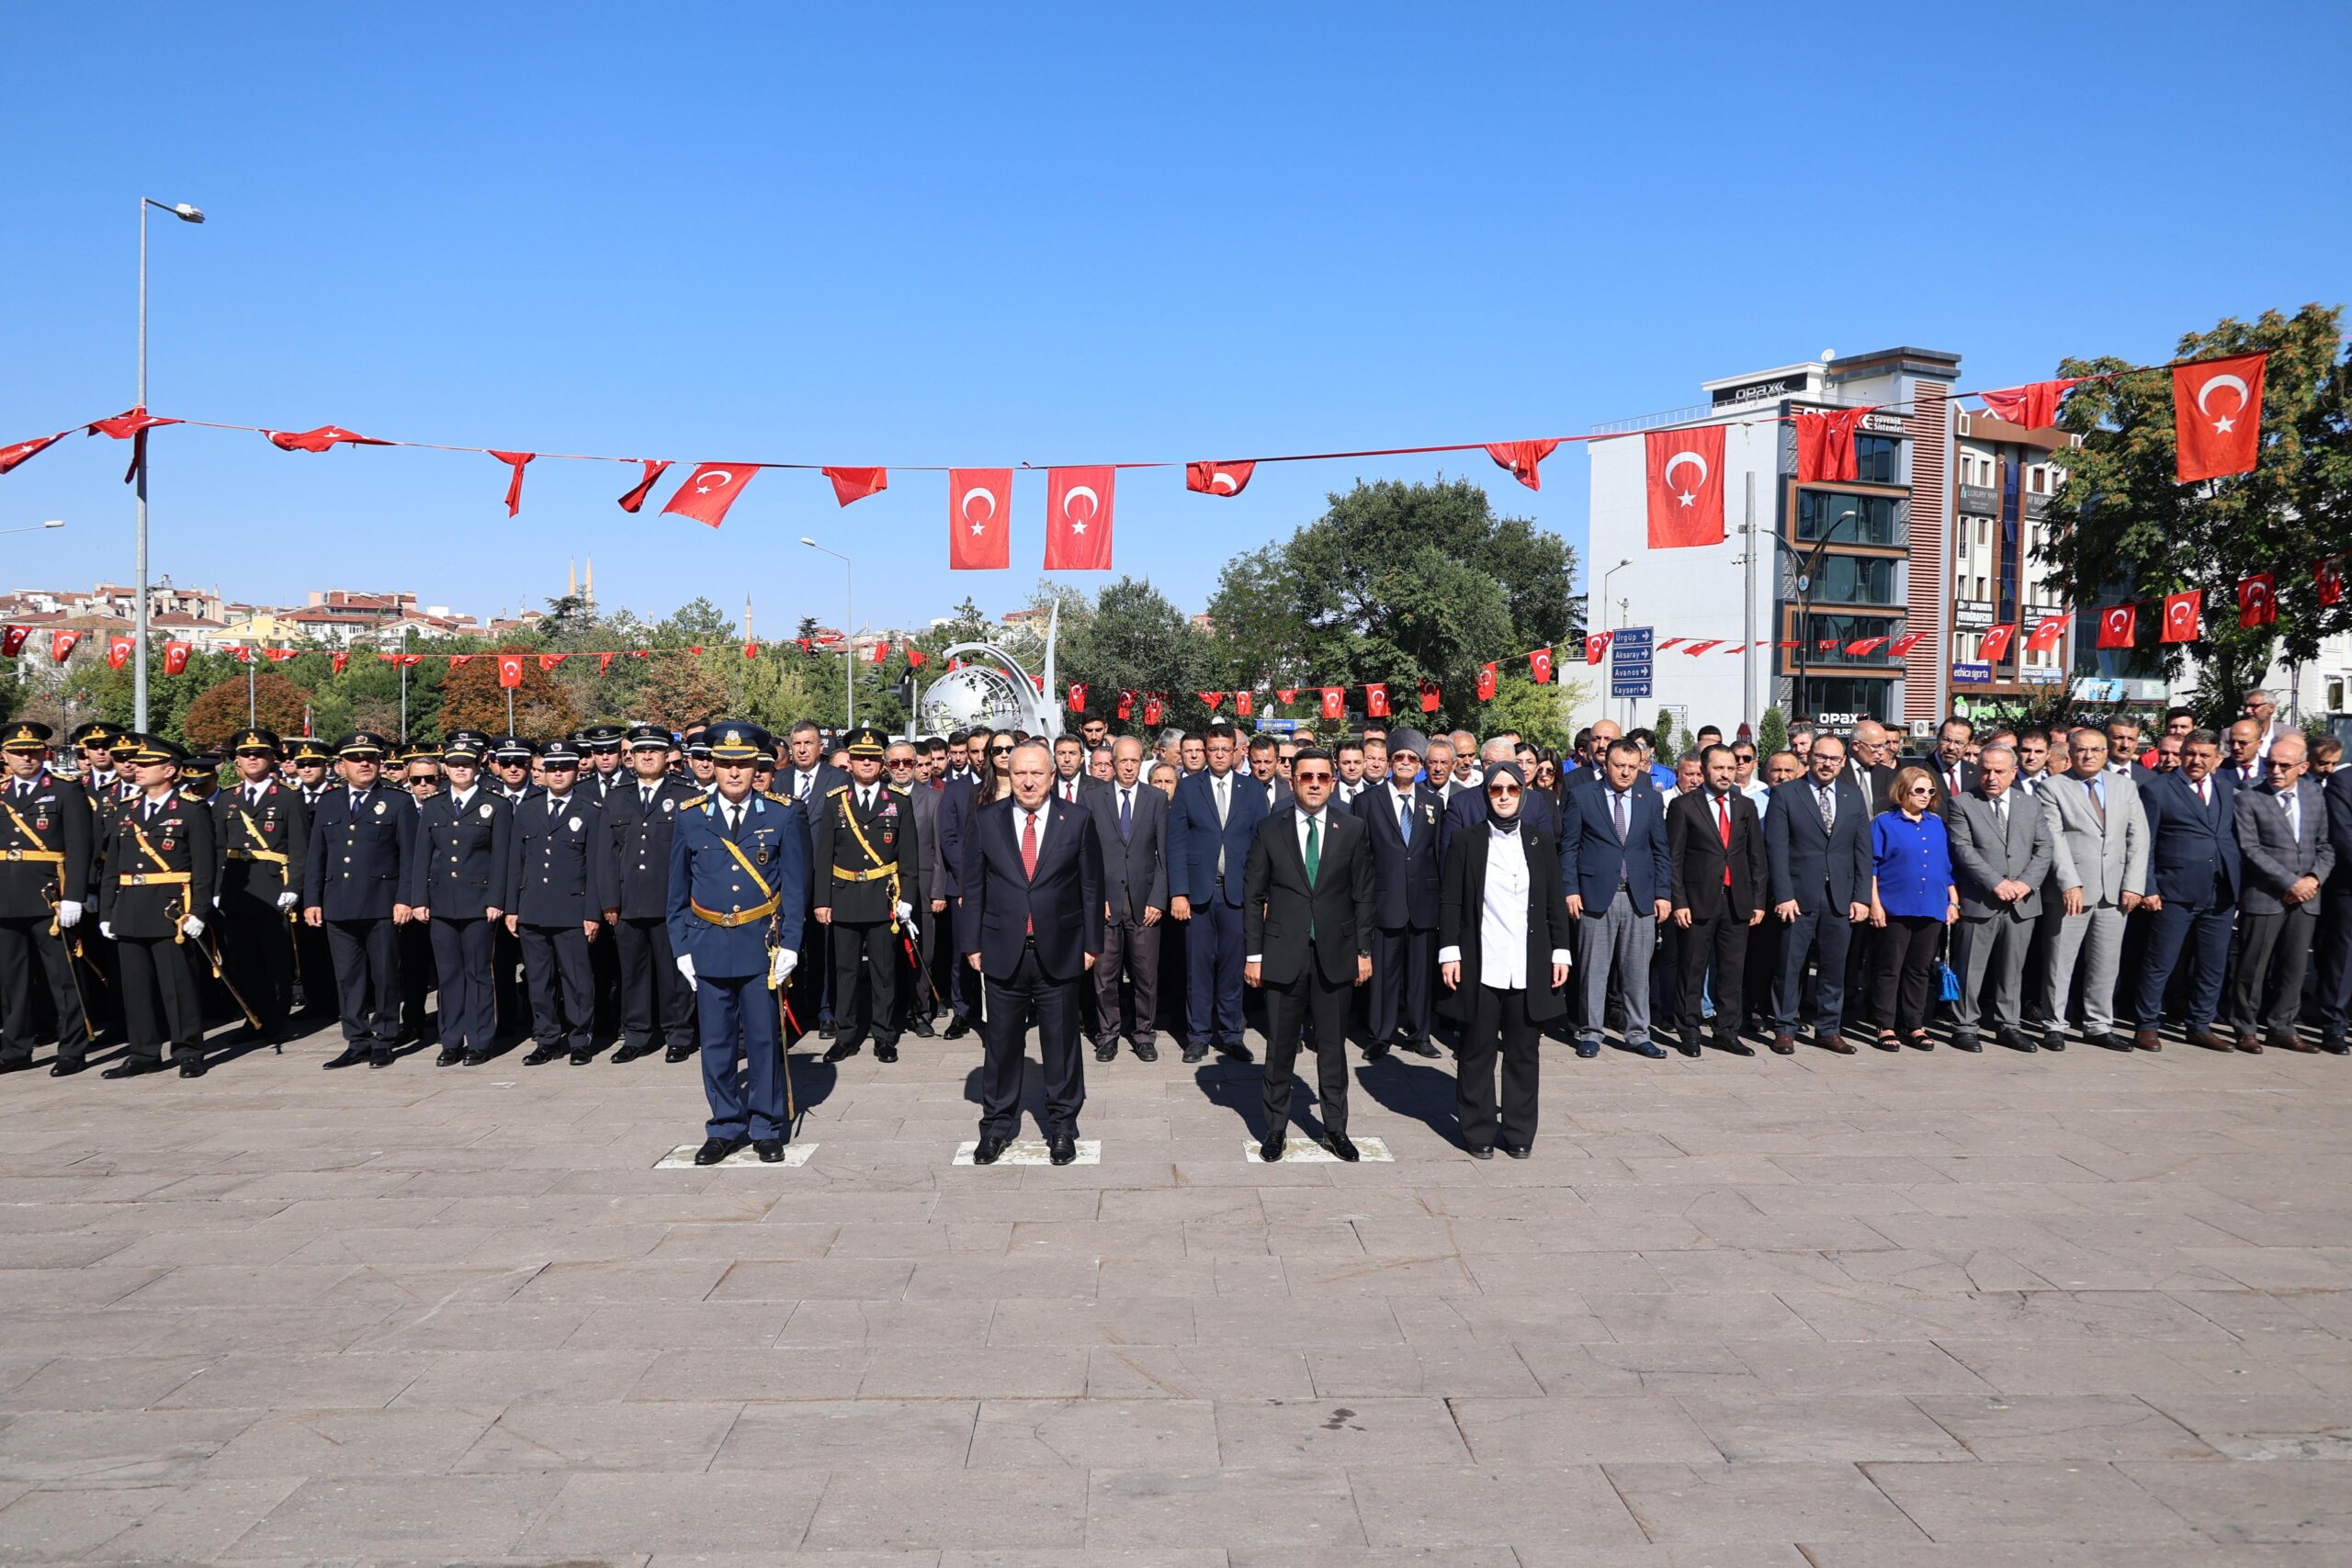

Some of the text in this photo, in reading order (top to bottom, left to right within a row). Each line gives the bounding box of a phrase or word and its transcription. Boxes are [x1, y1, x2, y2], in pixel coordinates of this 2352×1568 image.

[1874, 414, 1902, 424] Güvenlik
[1874, 423, 1905, 433] Sistemleri
[1615, 631, 1636, 642] Ürgüp
[1615, 649, 1640, 660] Aksaray
[1614, 669, 1640, 677] Avanos
[1953, 667, 1972, 678] ethica
[1614, 686, 1639, 695] Kayseri
